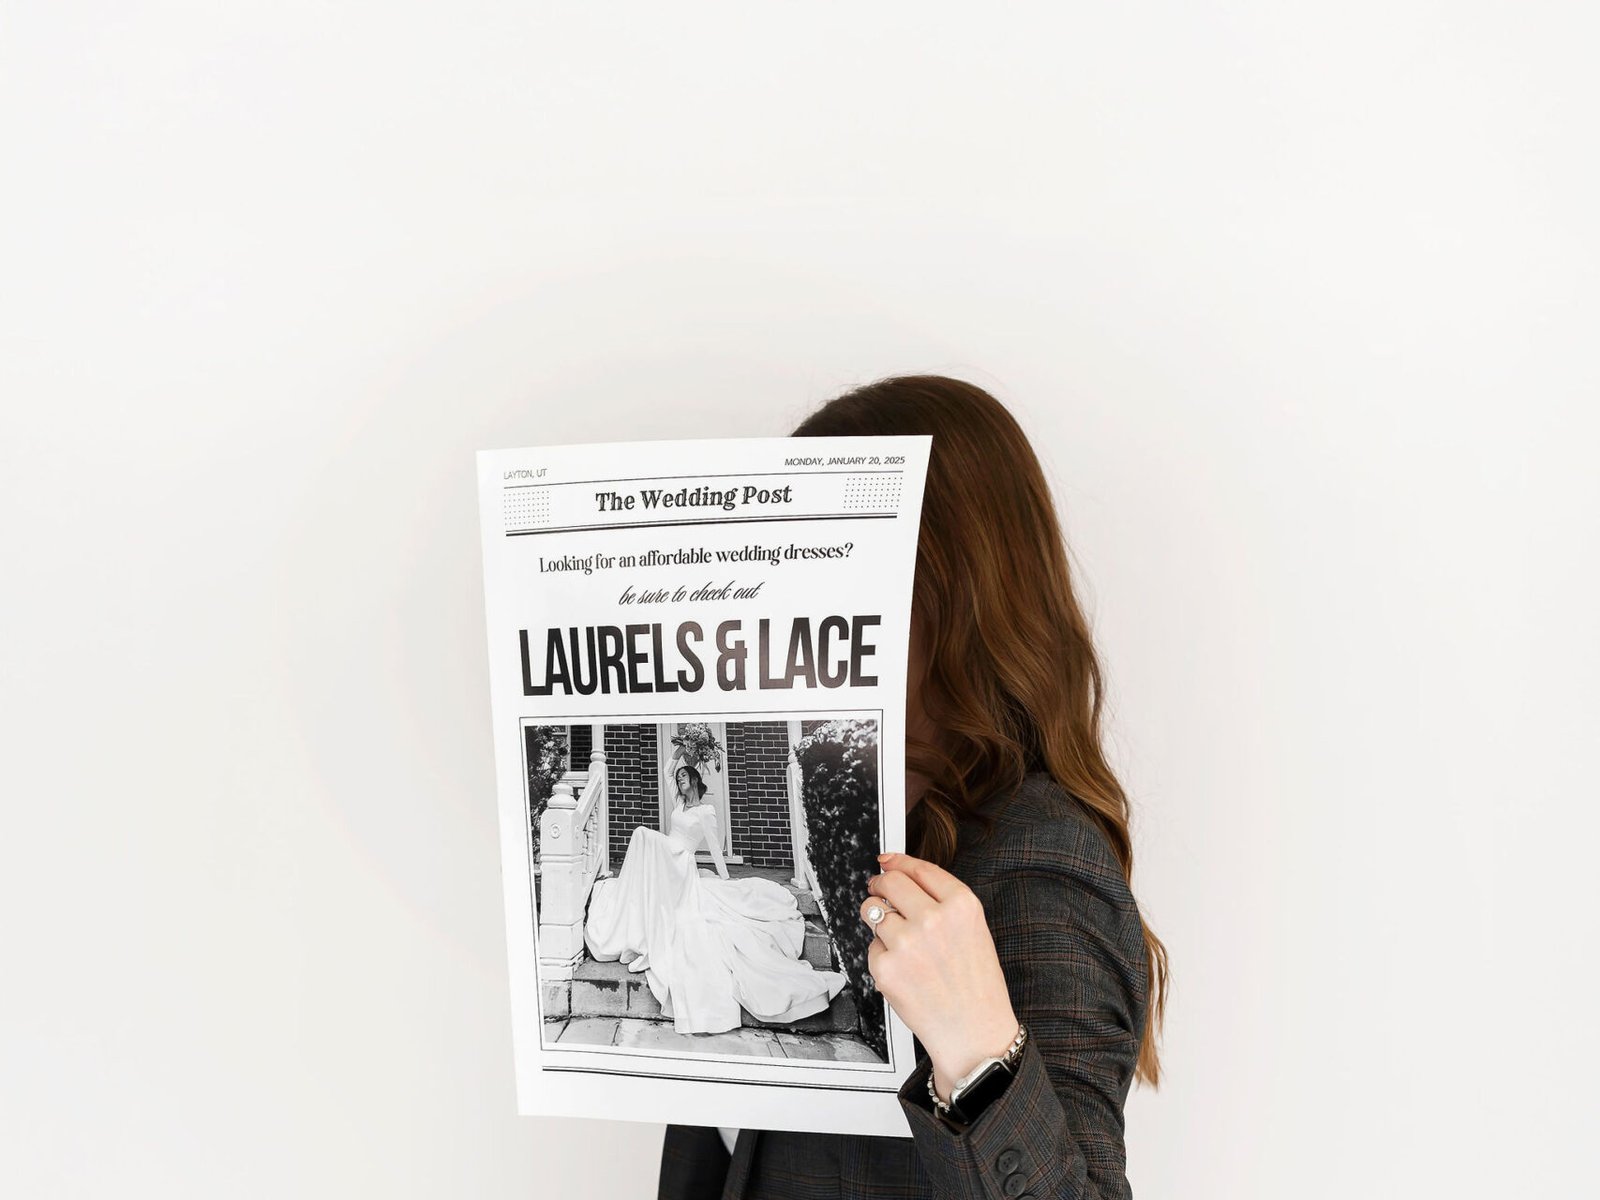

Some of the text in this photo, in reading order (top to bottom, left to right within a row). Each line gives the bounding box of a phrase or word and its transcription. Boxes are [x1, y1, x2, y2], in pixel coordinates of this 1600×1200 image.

[503, 468, 547, 480] LAYTON, UT
[784, 456, 905, 466] MONDAY, JANUARY 20, 2025
[595, 485, 792, 512] The Wedding Post
[539, 542, 854, 575] Looking for an affordable wedding dresses?
[618, 580, 765, 605] be sure to check out
[519, 614, 882, 696] LAURELS & LACE
